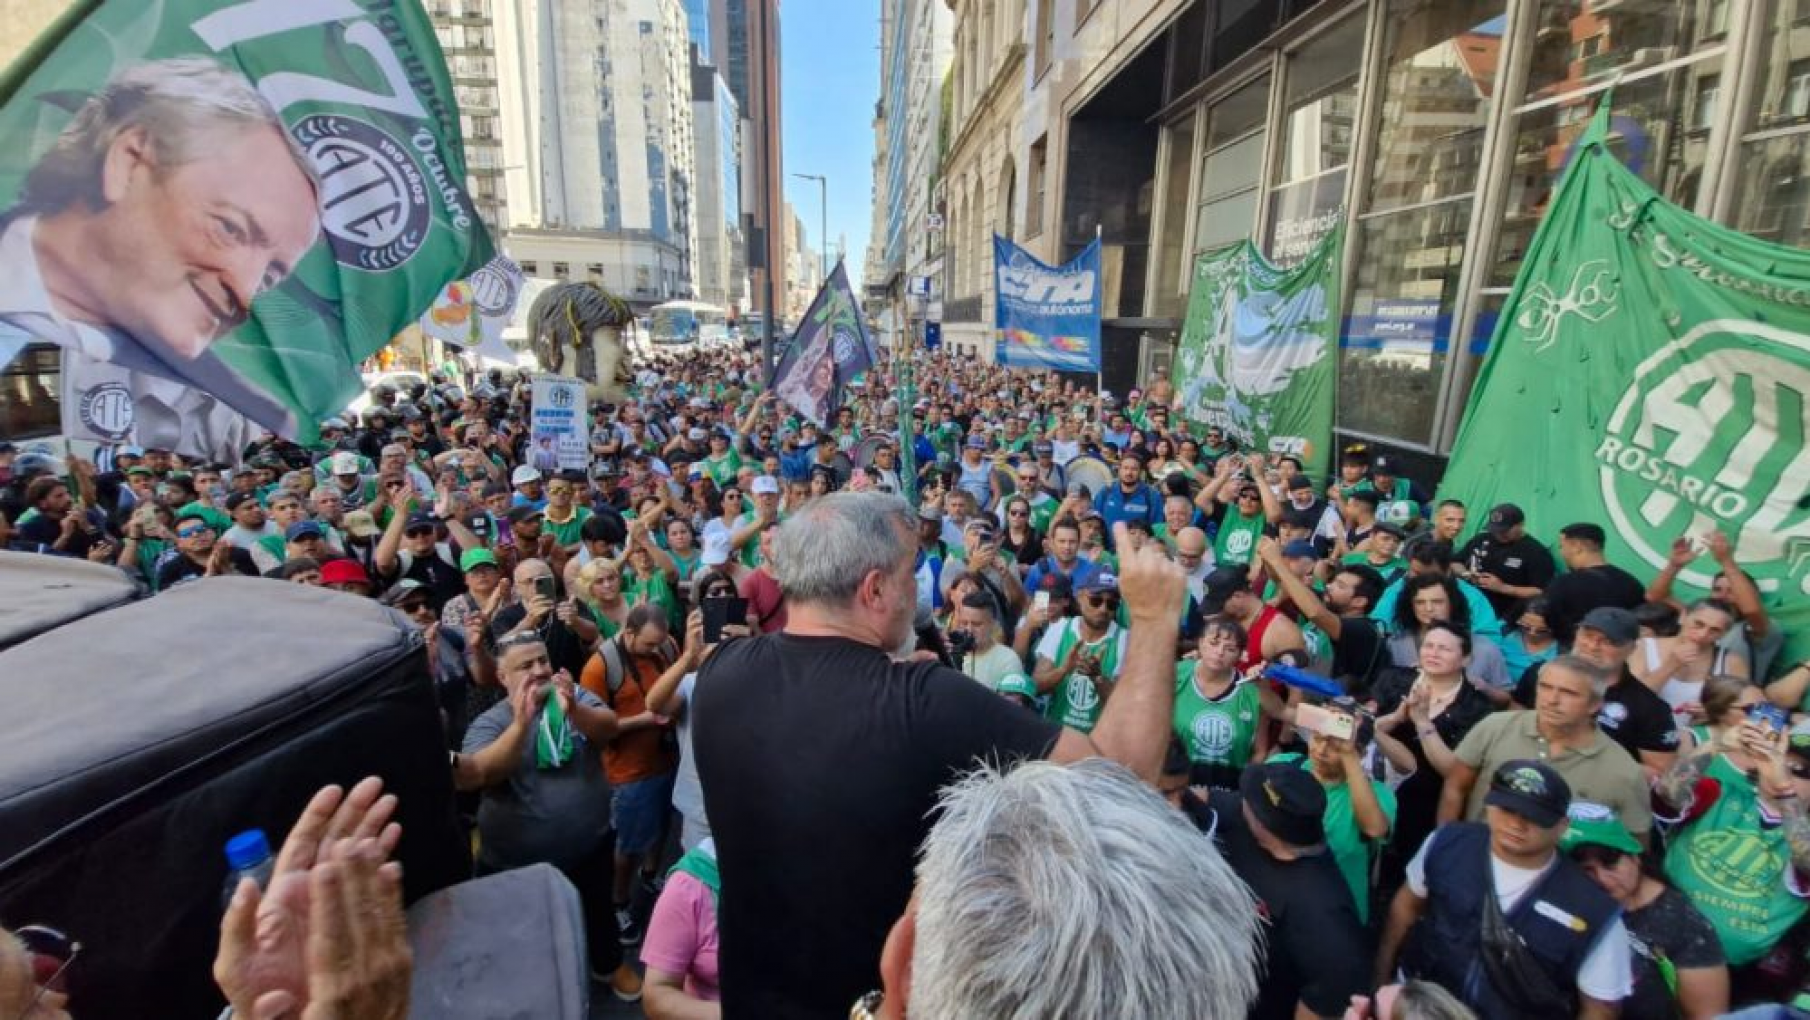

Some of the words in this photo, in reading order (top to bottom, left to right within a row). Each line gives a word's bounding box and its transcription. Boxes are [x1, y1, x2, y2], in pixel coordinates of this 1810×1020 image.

[380, 139, 404, 162] 100
[411, 127, 471, 231] Octubre
[316, 143, 405, 240] ATE
[1595, 436, 1748, 519] ROSARIO
[1069, 675, 1097, 709] ATE
[1197, 716, 1233, 749] ATE
